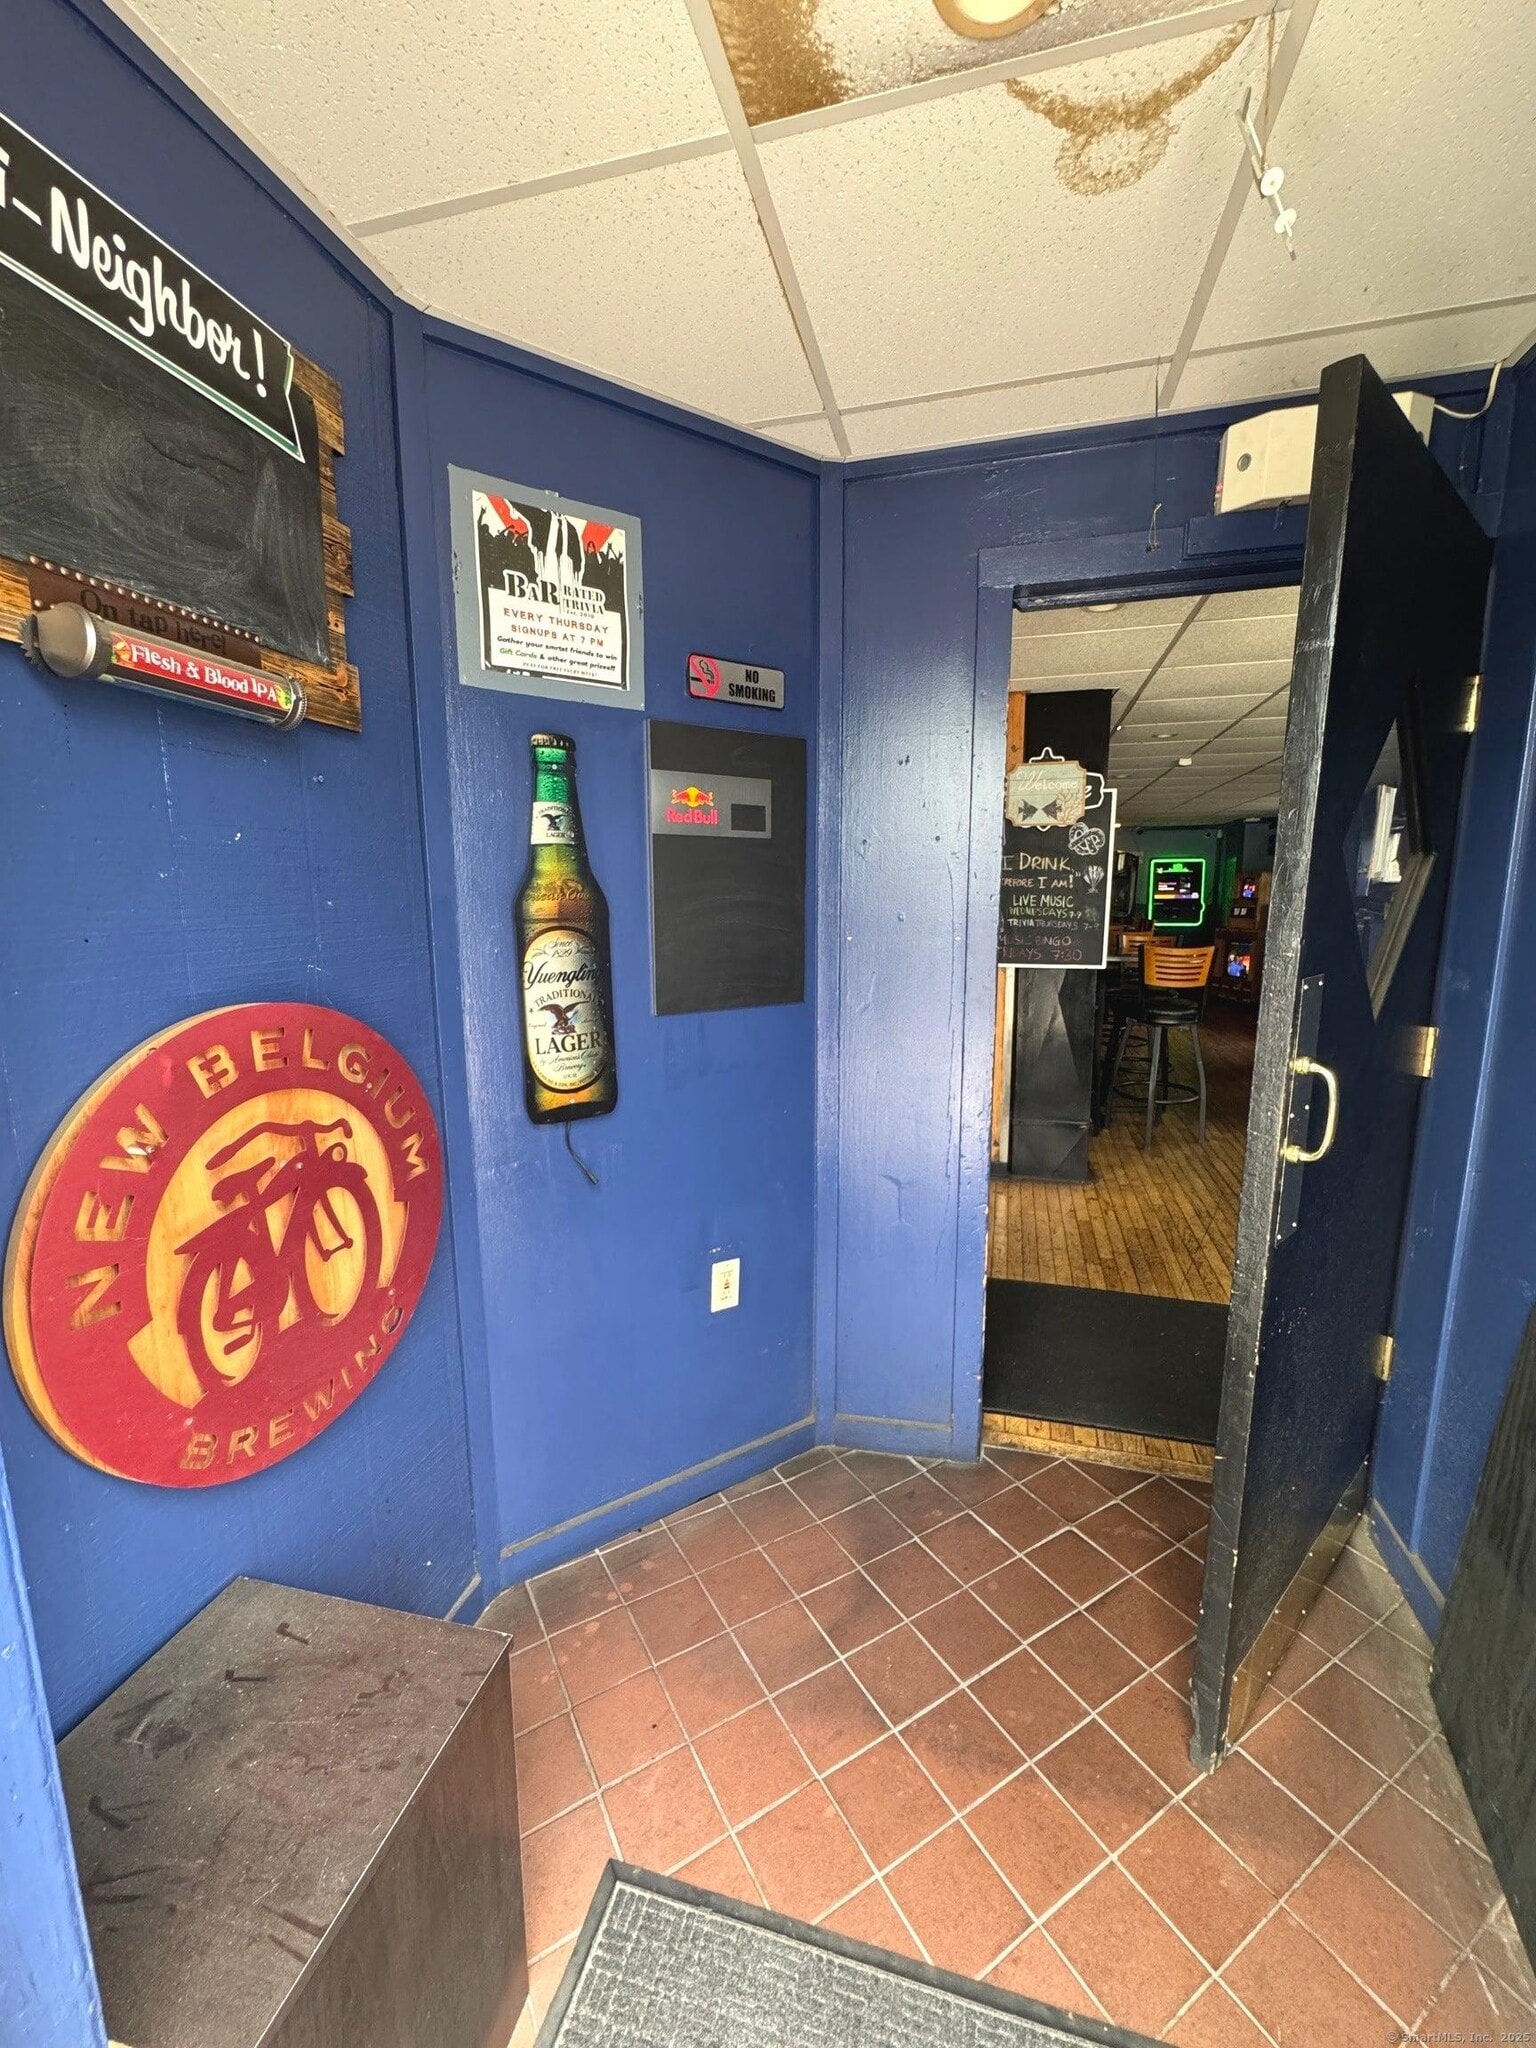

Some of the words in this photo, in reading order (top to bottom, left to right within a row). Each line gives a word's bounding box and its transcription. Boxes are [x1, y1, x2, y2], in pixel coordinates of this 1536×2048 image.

[0, 147, 267, 398] i-Neighbor!
[564, 584, 604, 602] RATED
[80, 589, 118, 621] On
[128, 608, 169, 633] tap
[564, 599, 604, 615] TRIVIA
[503, 608, 543, 622] EVERY
[549, 616, 608, 634] THURSDAY
[497, 635, 523, 645] Gather
[525, 641, 543, 649] your
[570, 647, 594, 657] friends
[511, 624, 557, 640] SIGNUPS
[562, 633, 576, 642] AT
[580, 636, 586, 644] 7
[590, 637, 604, 647] PM
[499, 647, 514, 655] Gift
[515, 650, 538, 659] Cards
[547, 655, 567, 664] other
[569, 659, 588, 668] great
[131, 642, 182, 675] Flesh
[186, 660, 200, 680] &
[205, 666, 249, 695] Blood
[251, 679, 279, 703] IPA
[745, 669, 760, 684] NO
[728, 683, 776, 703] SMOKING
[1017, 770, 1078, 791] Welcome
[1002, 855, 1014, 870] I
[1037, 876, 1048, 889] I
[1013, 893, 1037, 907] LIVE
[1040, 894, 1074, 908] MUSIC
[1009, 906, 1068, 919] WEDNESDAYS
[1007, 918, 1035, 927] TRIVIA
[1035, 919, 1079, 931] THURSDAYS
[1051, 949, 1083, 961] 7:30
[535, 1031, 602, 1055] LAGER
[65, 1103, 169, 1331] NEW
[186, 1026, 430, 1183] BELGIUM
[178, 1304, 403, 1471] BREWING
